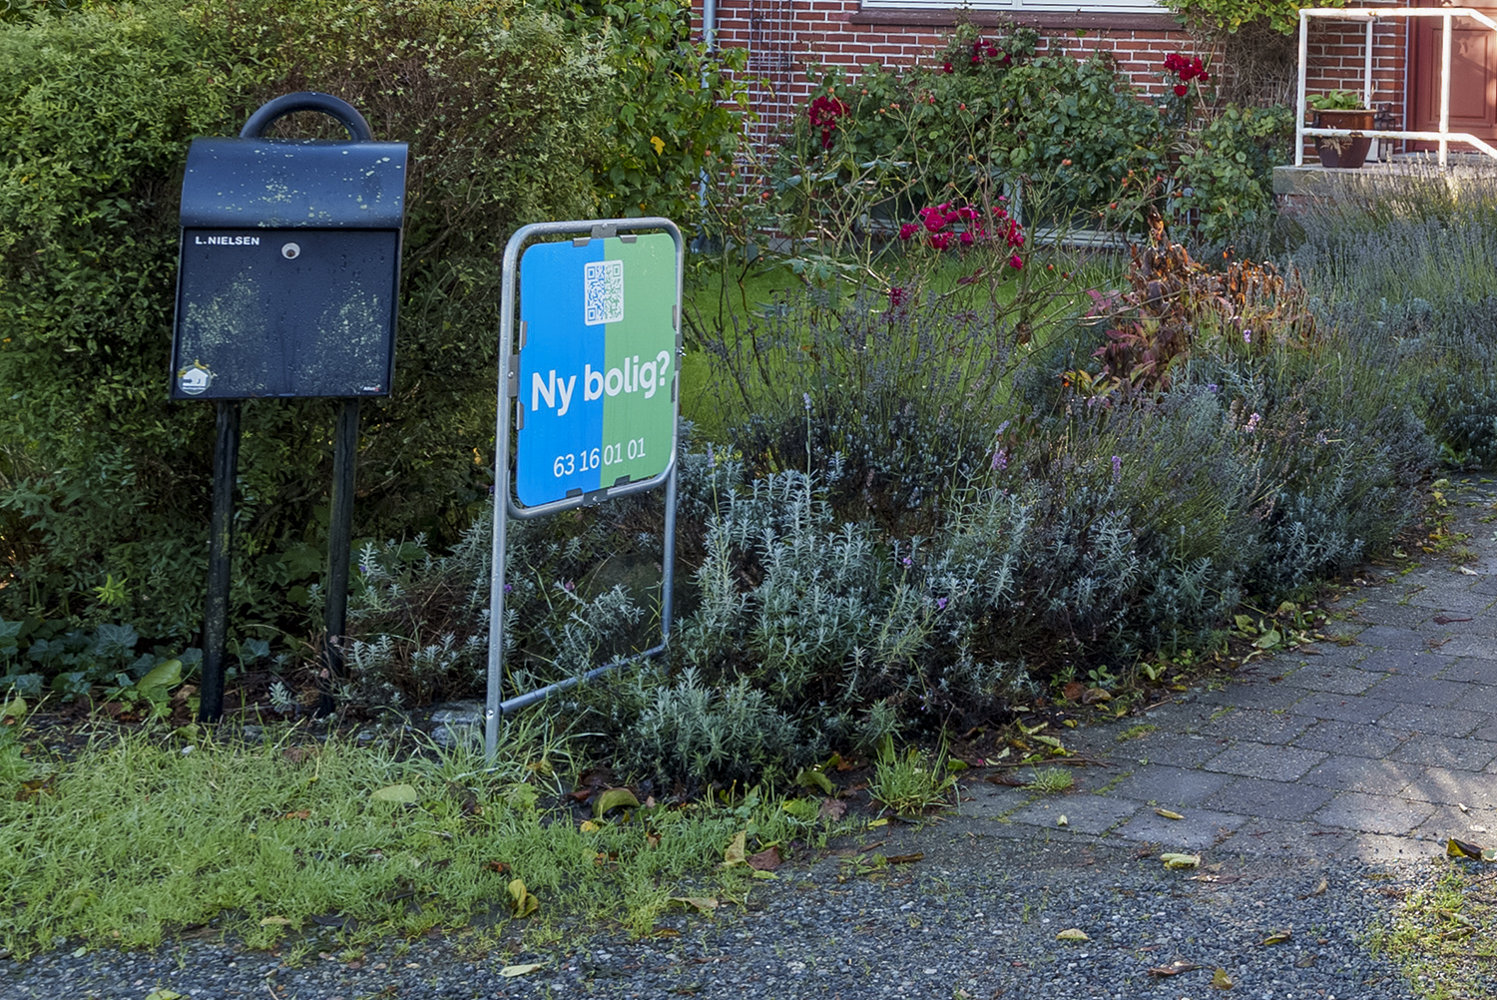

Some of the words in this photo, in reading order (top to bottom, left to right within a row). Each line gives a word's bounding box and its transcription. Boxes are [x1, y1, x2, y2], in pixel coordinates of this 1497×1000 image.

[531, 369, 577, 417] Ny
[584, 350, 670, 401] bolig?
[553, 453, 575, 478] 63
[579, 447, 600, 472] 16
[603, 442, 623, 466] 01
[627, 437, 646, 460] 01
